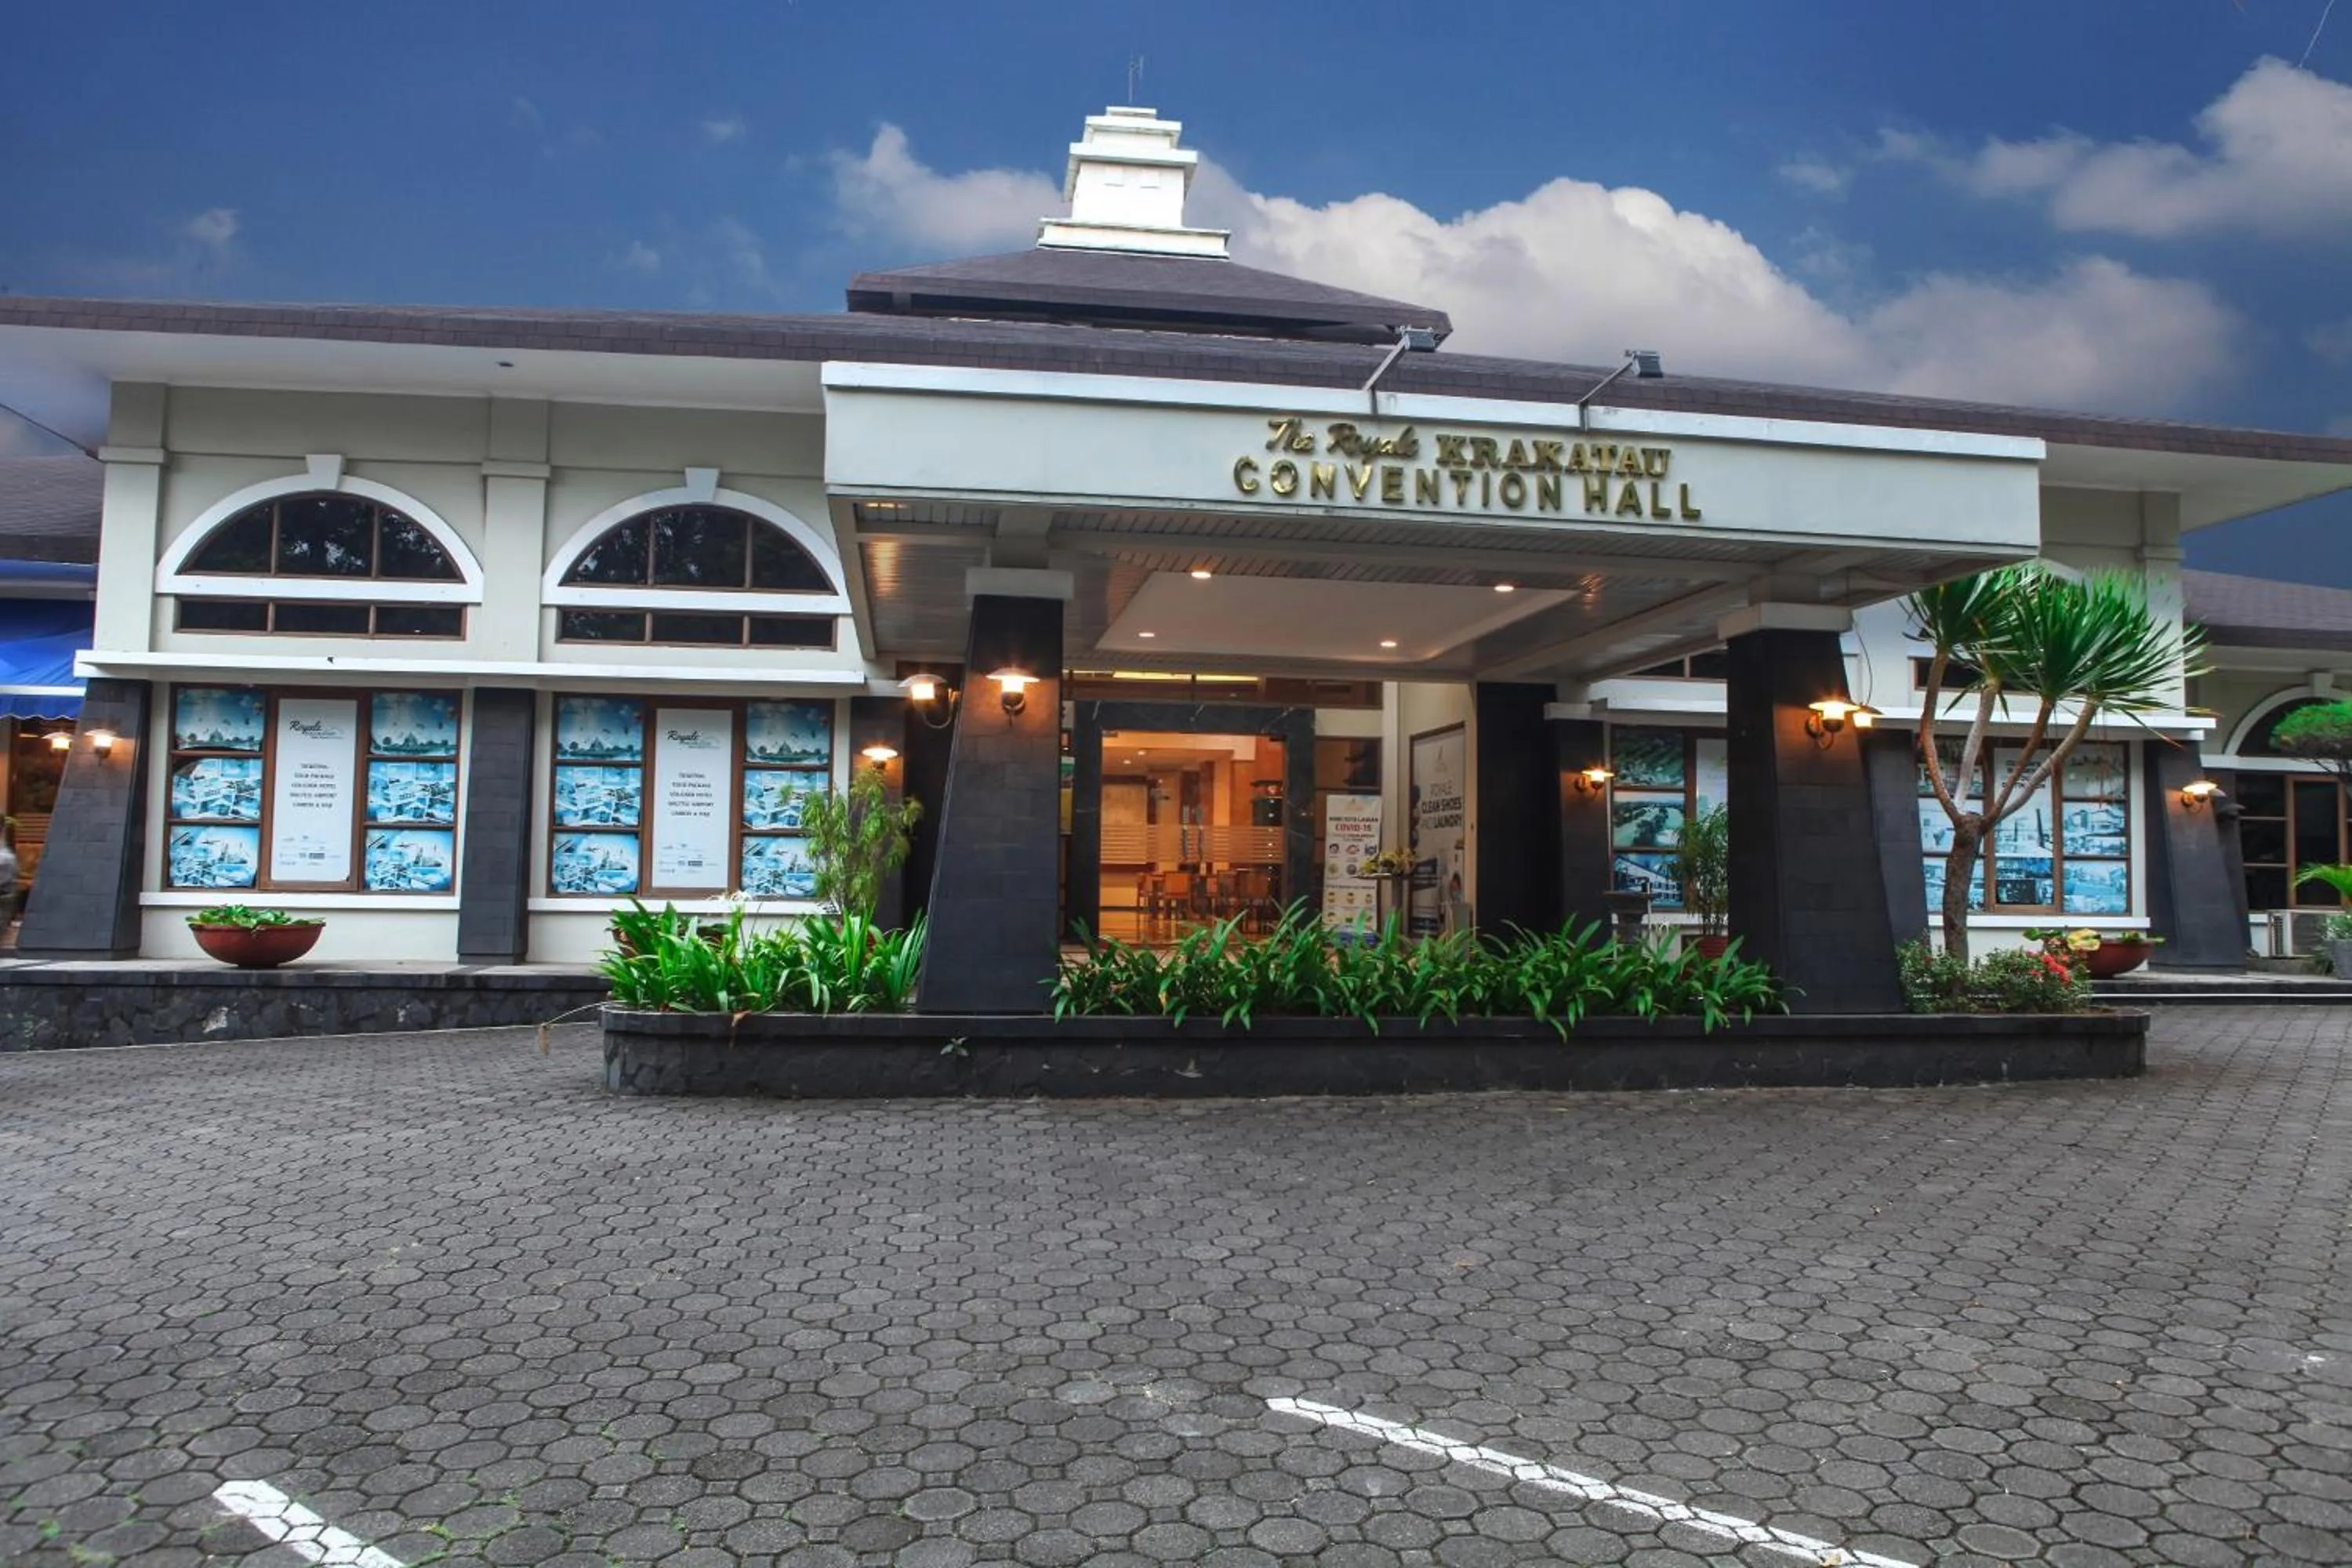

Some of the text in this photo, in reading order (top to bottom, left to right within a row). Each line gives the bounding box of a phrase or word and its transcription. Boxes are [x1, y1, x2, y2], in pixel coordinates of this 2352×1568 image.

[1265, 418, 1315, 451] The
[1436, 434, 1671, 478] KRAKATAU
[1233, 456, 1702, 519] CONVENTION HALL
